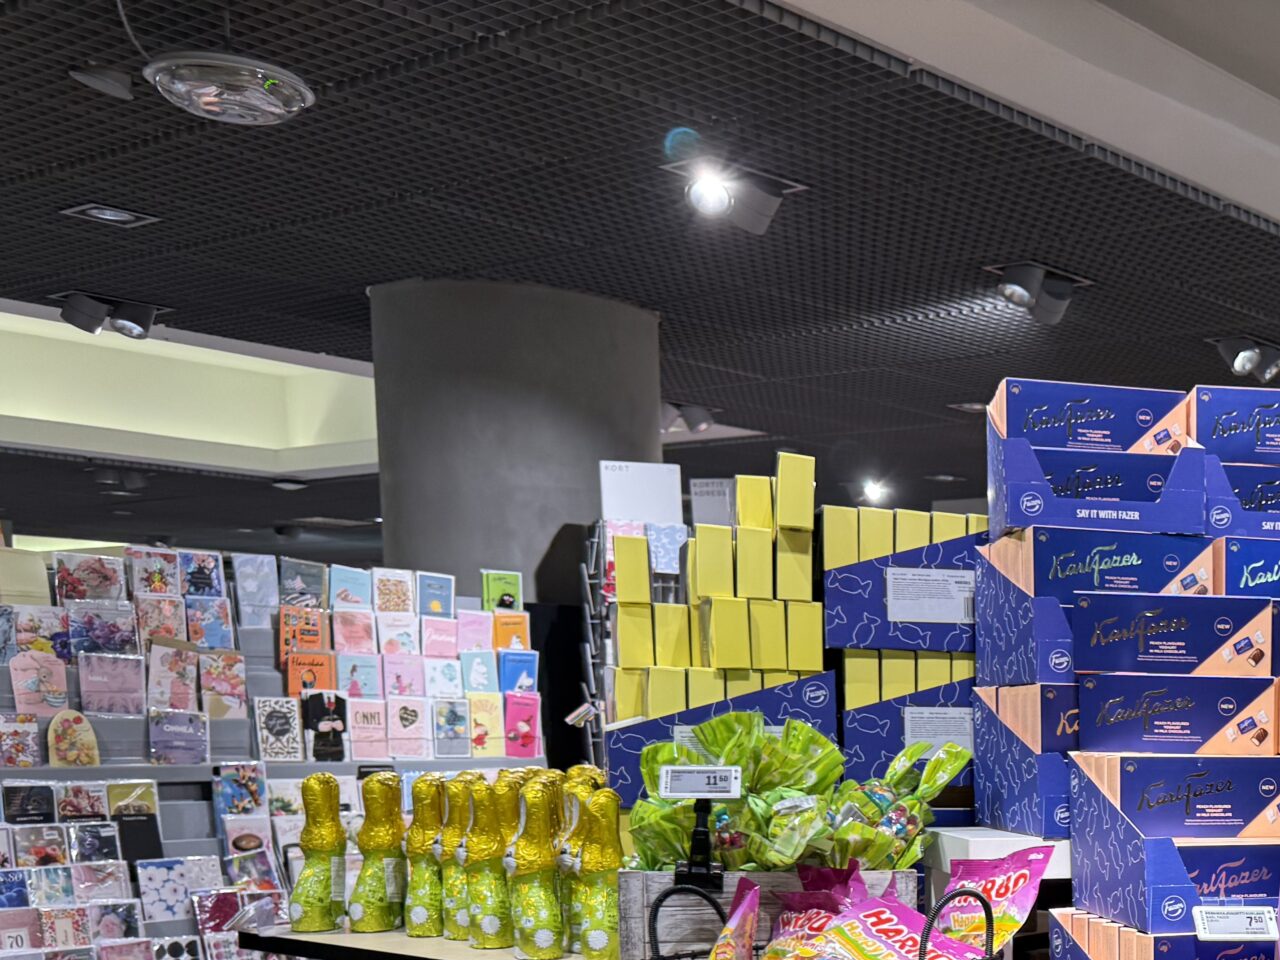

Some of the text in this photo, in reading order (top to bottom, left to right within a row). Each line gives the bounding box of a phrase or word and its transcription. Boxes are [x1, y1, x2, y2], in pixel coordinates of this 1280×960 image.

[1076, 509, 1140, 521] SAY IT WITH FAZER
[1261, 521, 1274, 530] SAY
[1275, 522, 1280, 530] IT
[355, 711, 382, 726] ONNI
[7, 934, 24, 949] 70
